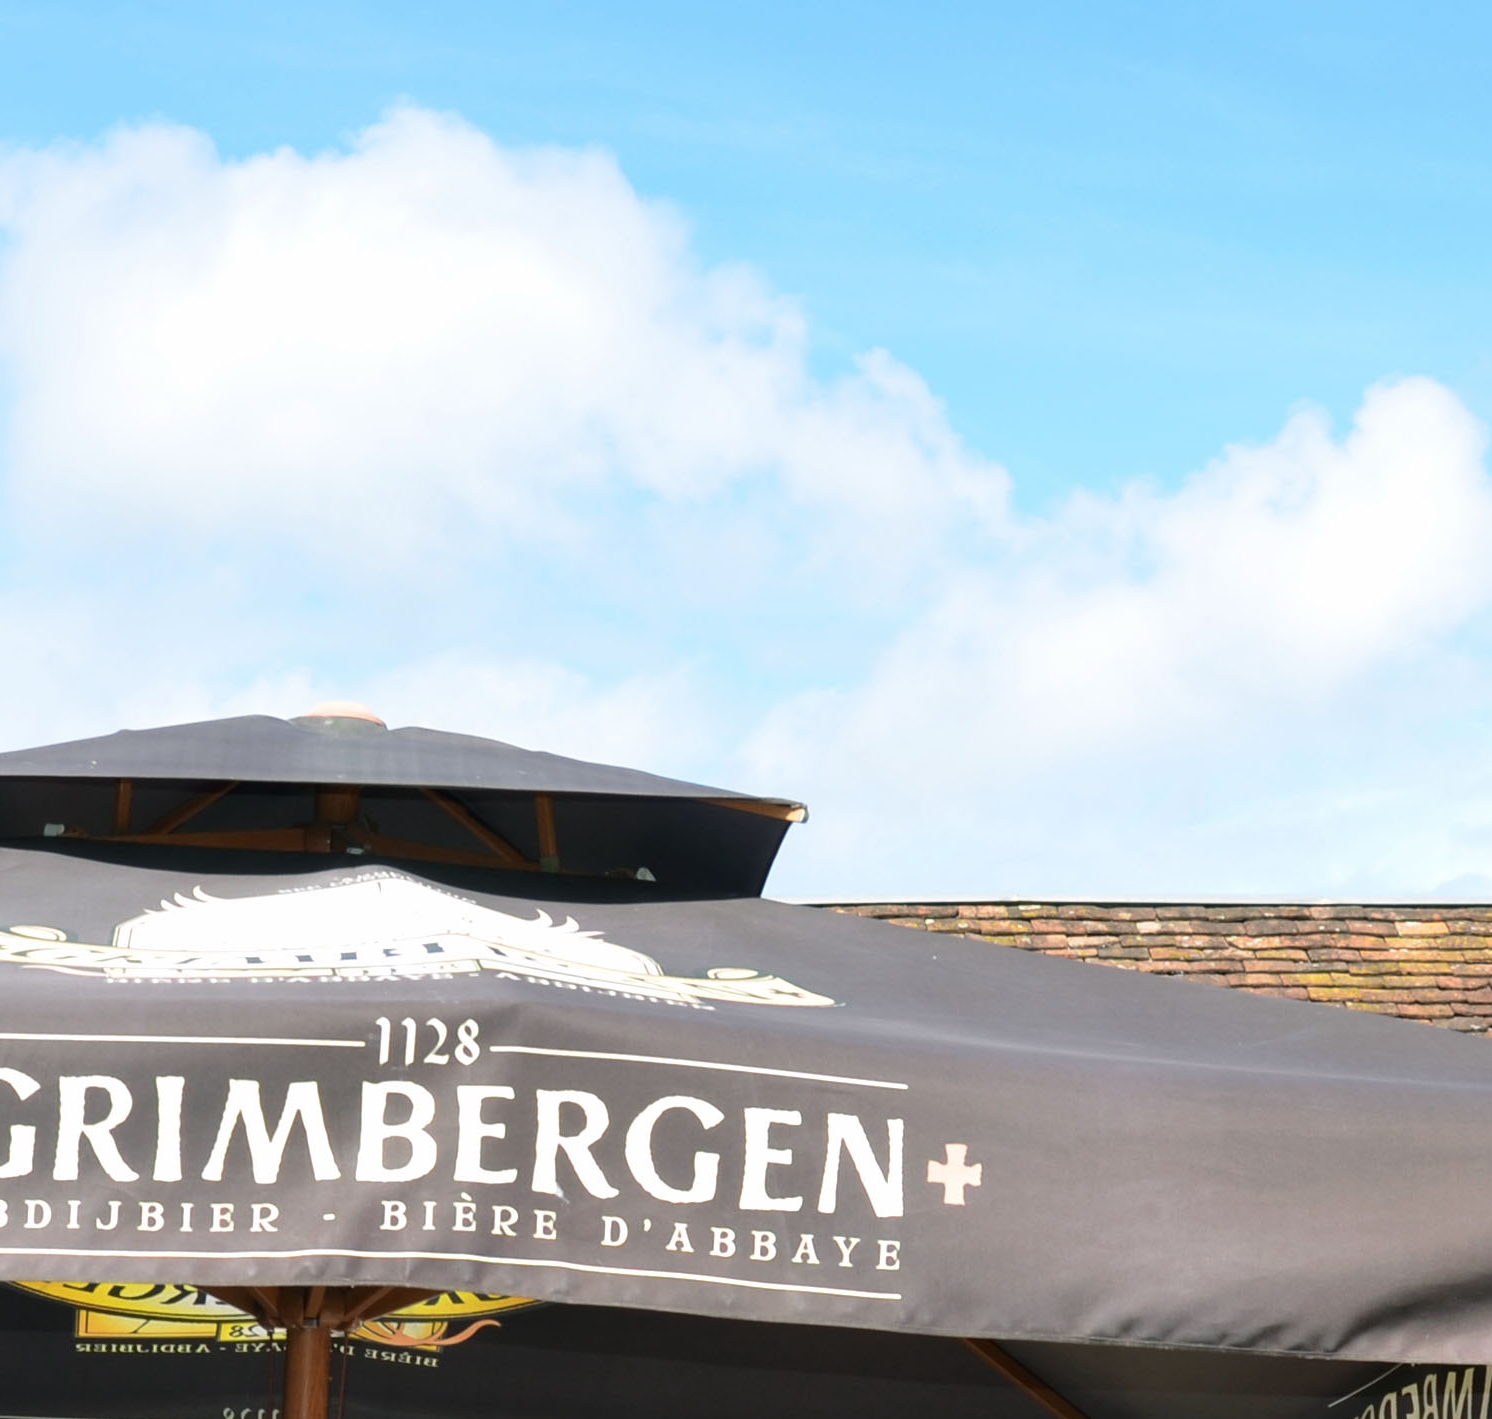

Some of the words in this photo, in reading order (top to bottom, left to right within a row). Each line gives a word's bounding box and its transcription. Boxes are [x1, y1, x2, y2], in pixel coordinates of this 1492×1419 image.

[376, 1017, 481, 1068] 1128
[380, 1191, 559, 1241] BIÈRE
[602, 1216, 903, 1273] D'ABBAYE
